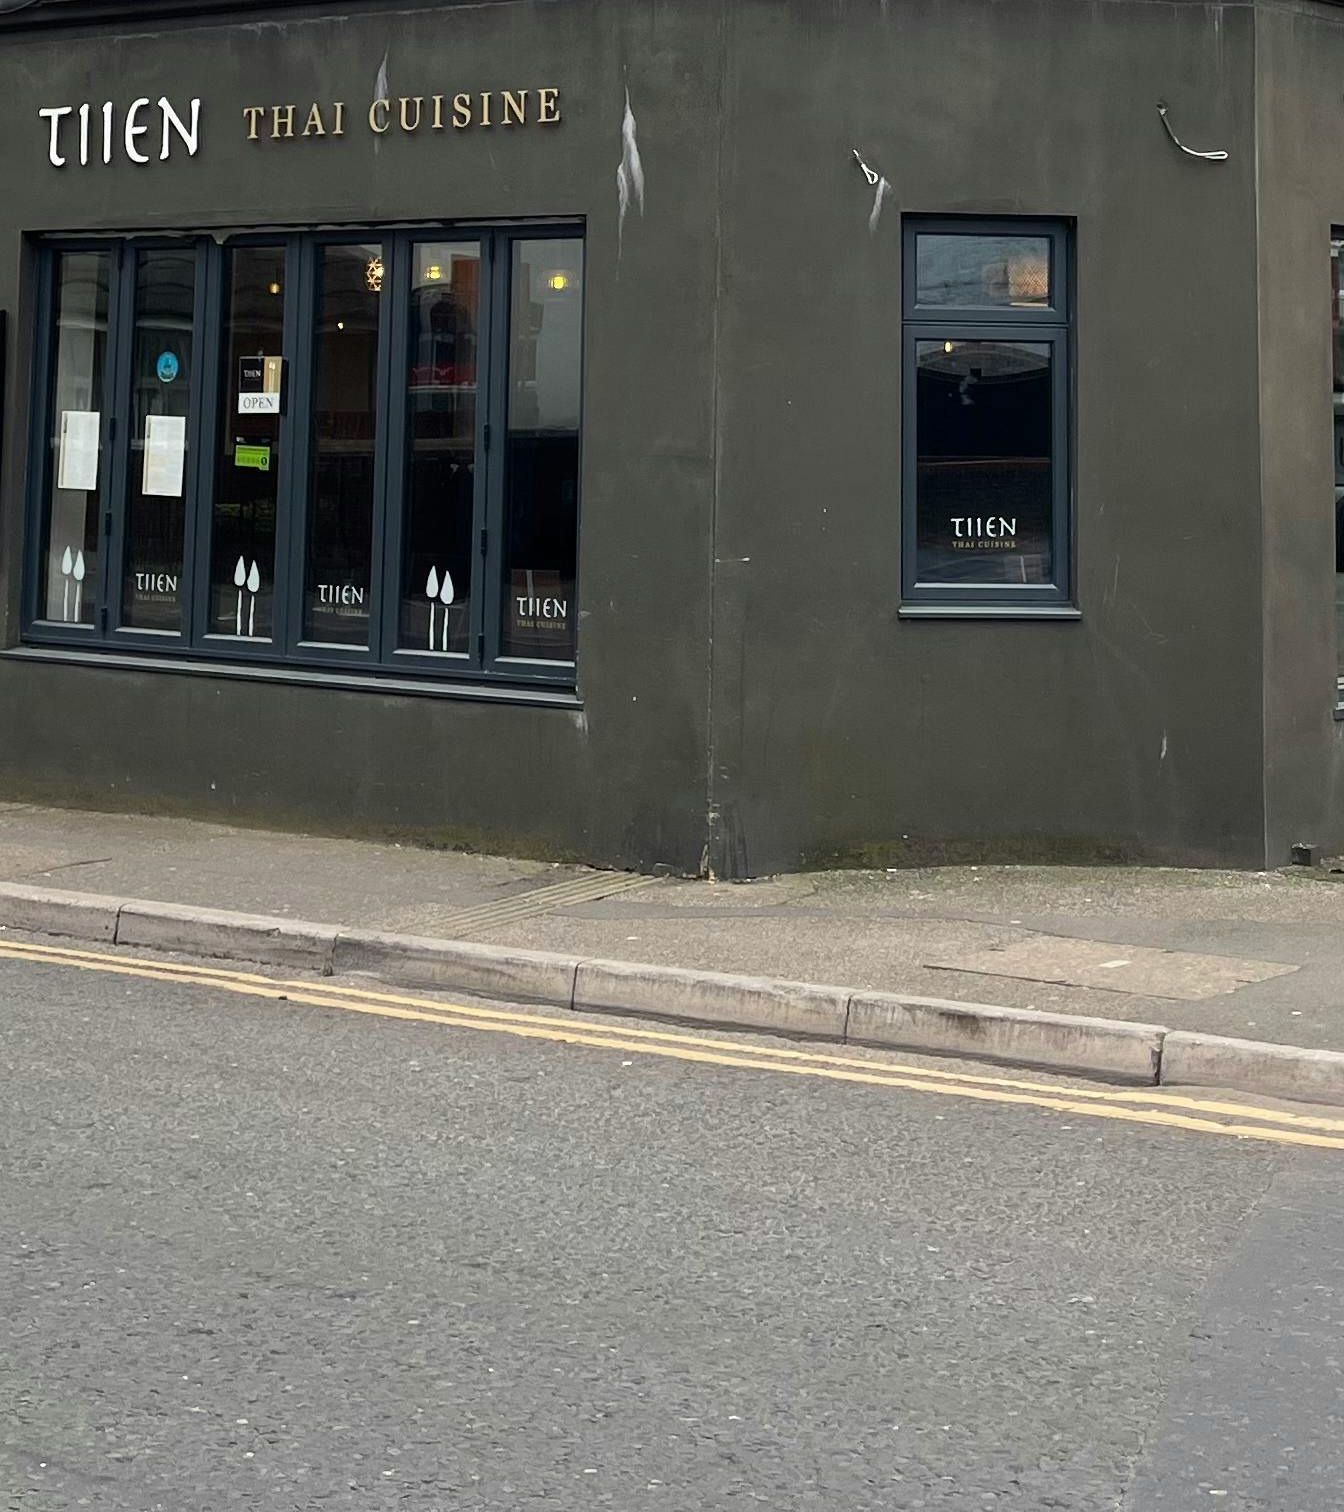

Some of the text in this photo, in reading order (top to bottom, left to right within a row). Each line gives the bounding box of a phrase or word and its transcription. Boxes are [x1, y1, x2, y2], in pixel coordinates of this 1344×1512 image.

[39, 88, 560, 167] TIIEN THAI CUISINE
[243, 396, 274, 409] OPEN
[950, 516, 1016, 538] TIIEN
[952, 540, 1016, 549] THAI CUISINE
[136, 573, 177, 592] TIIEN
[317, 584, 364, 604] TIIEN
[516, 596, 567, 619] TIIEN
